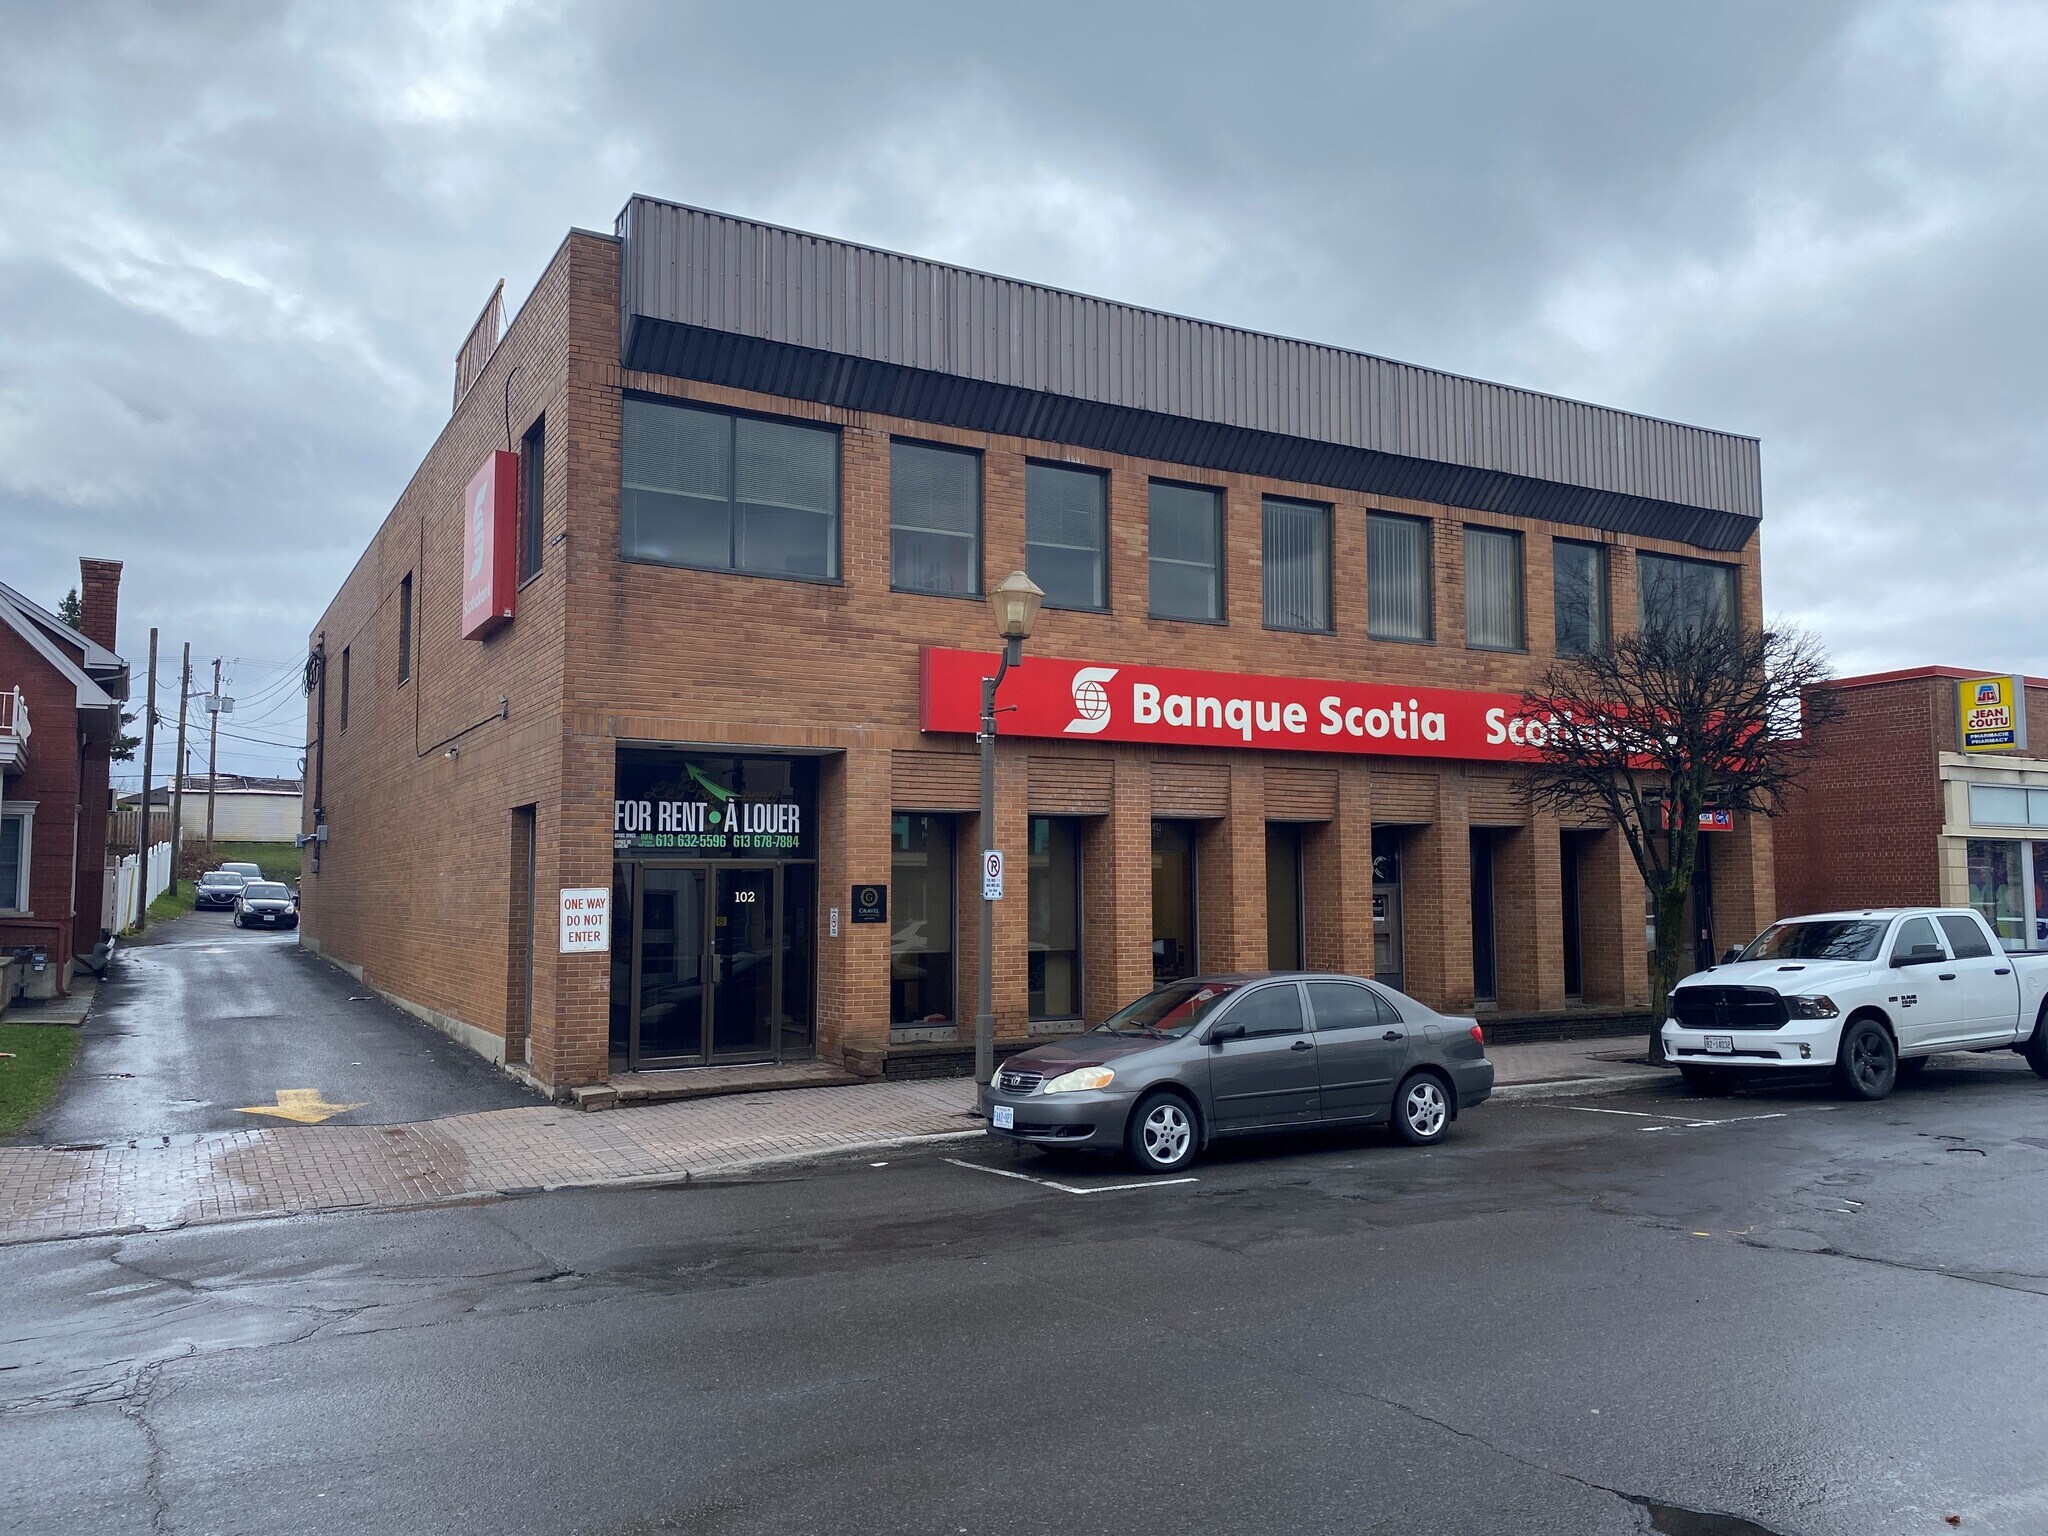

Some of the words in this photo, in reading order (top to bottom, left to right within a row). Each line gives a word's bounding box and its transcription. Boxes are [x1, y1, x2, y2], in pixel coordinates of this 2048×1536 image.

[1133, 684, 1308, 741] Banque
[1320, 696, 1446, 741] Scotia
[1973, 708, 2004, 719] JEAN
[1968, 717, 2008, 728] COUTU
[1970, 731, 2010, 739] PHARMACIE
[1971, 737, 2009, 745] PHARMACY
[614, 800, 652, 831] FOR
[658, 801, 708, 832] RENT
[743, 803, 800, 833] LOUER
[655, 833, 674, 847] 613
[677, 834, 726, 848] 632-5596
[733, 834, 751, 848] 613
[754, 835, 800, 848] 678-7884
[734, 891, 755, 903] 102
[564, 898, 584, 910] ONE
[586, 897, 606, 909] WAY
[566, 915, 581, 926] DO
[584, 914, 603, 926] NOT
[568, 930, 601, 943] ENTER
